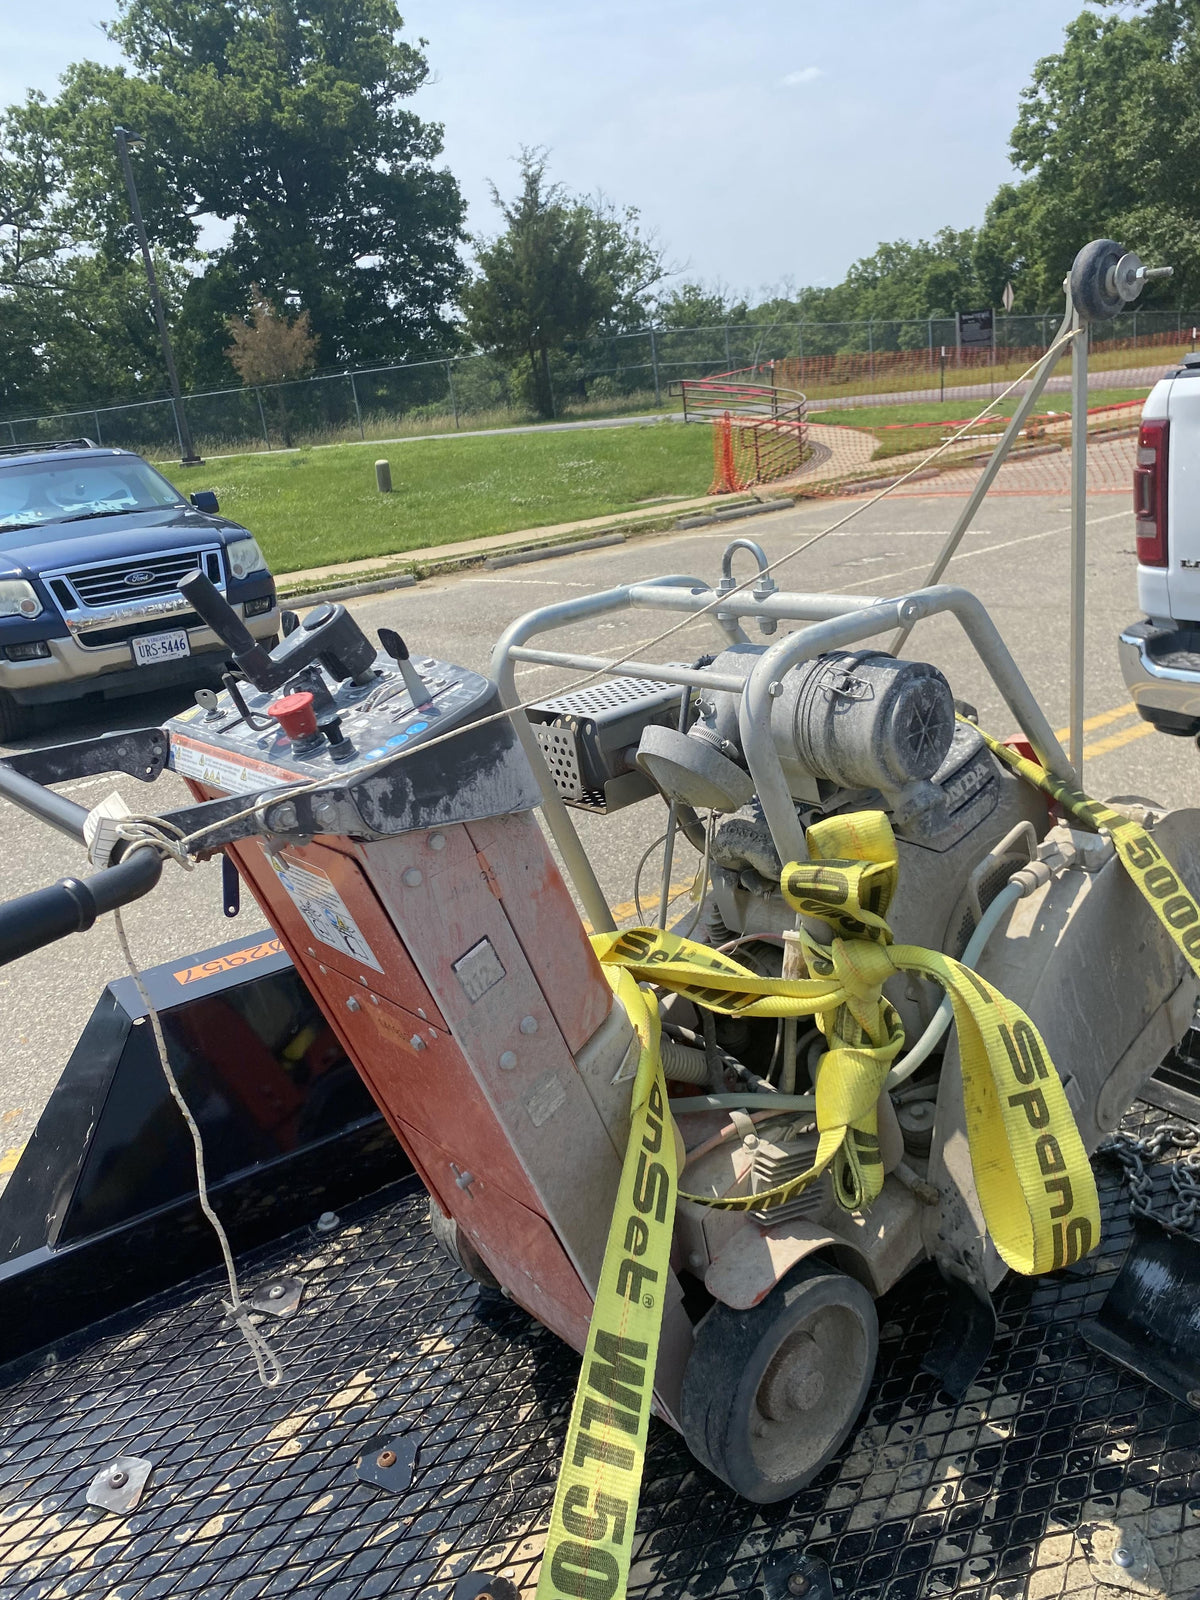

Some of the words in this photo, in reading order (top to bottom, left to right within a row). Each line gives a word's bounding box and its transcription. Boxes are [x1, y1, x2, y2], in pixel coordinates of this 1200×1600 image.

[138, 638, 187, 658] URS-5446
[944, 763, 989, 808] NDA
[572, 1329, 649, 1471] WLL
[551, 1484, 629, 1600] 50
